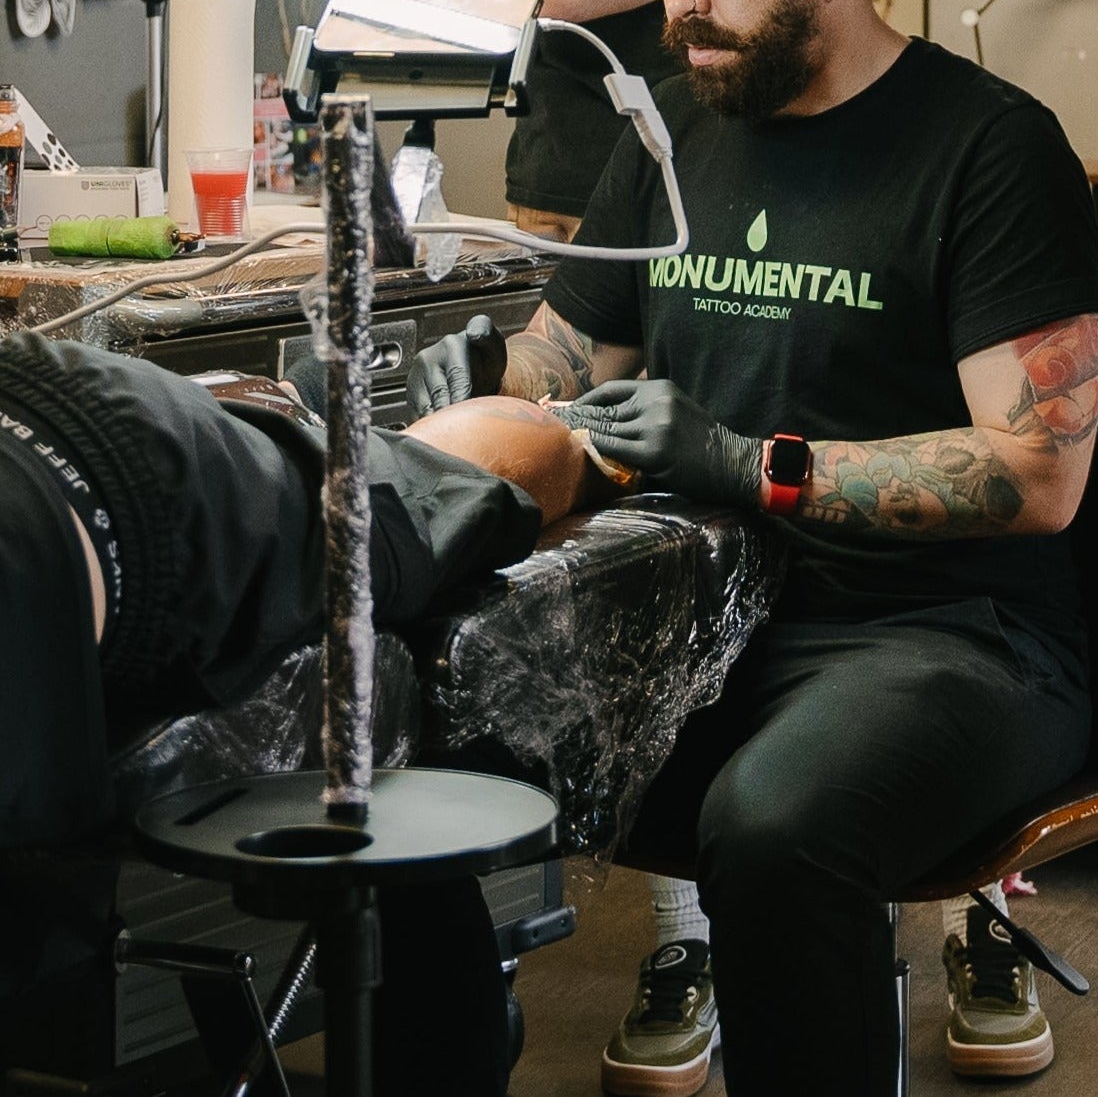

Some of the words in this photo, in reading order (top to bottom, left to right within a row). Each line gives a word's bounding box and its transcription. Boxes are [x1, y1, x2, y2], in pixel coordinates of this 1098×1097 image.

[650, 254, 883, 310] MONUMENTAL
[693, 298, 742, 315] TATTOO
[743, 304, 792, 320] ACADEMY
[0, 411, 34, 440] BA
[33, 442, 90, 494] JEFF
